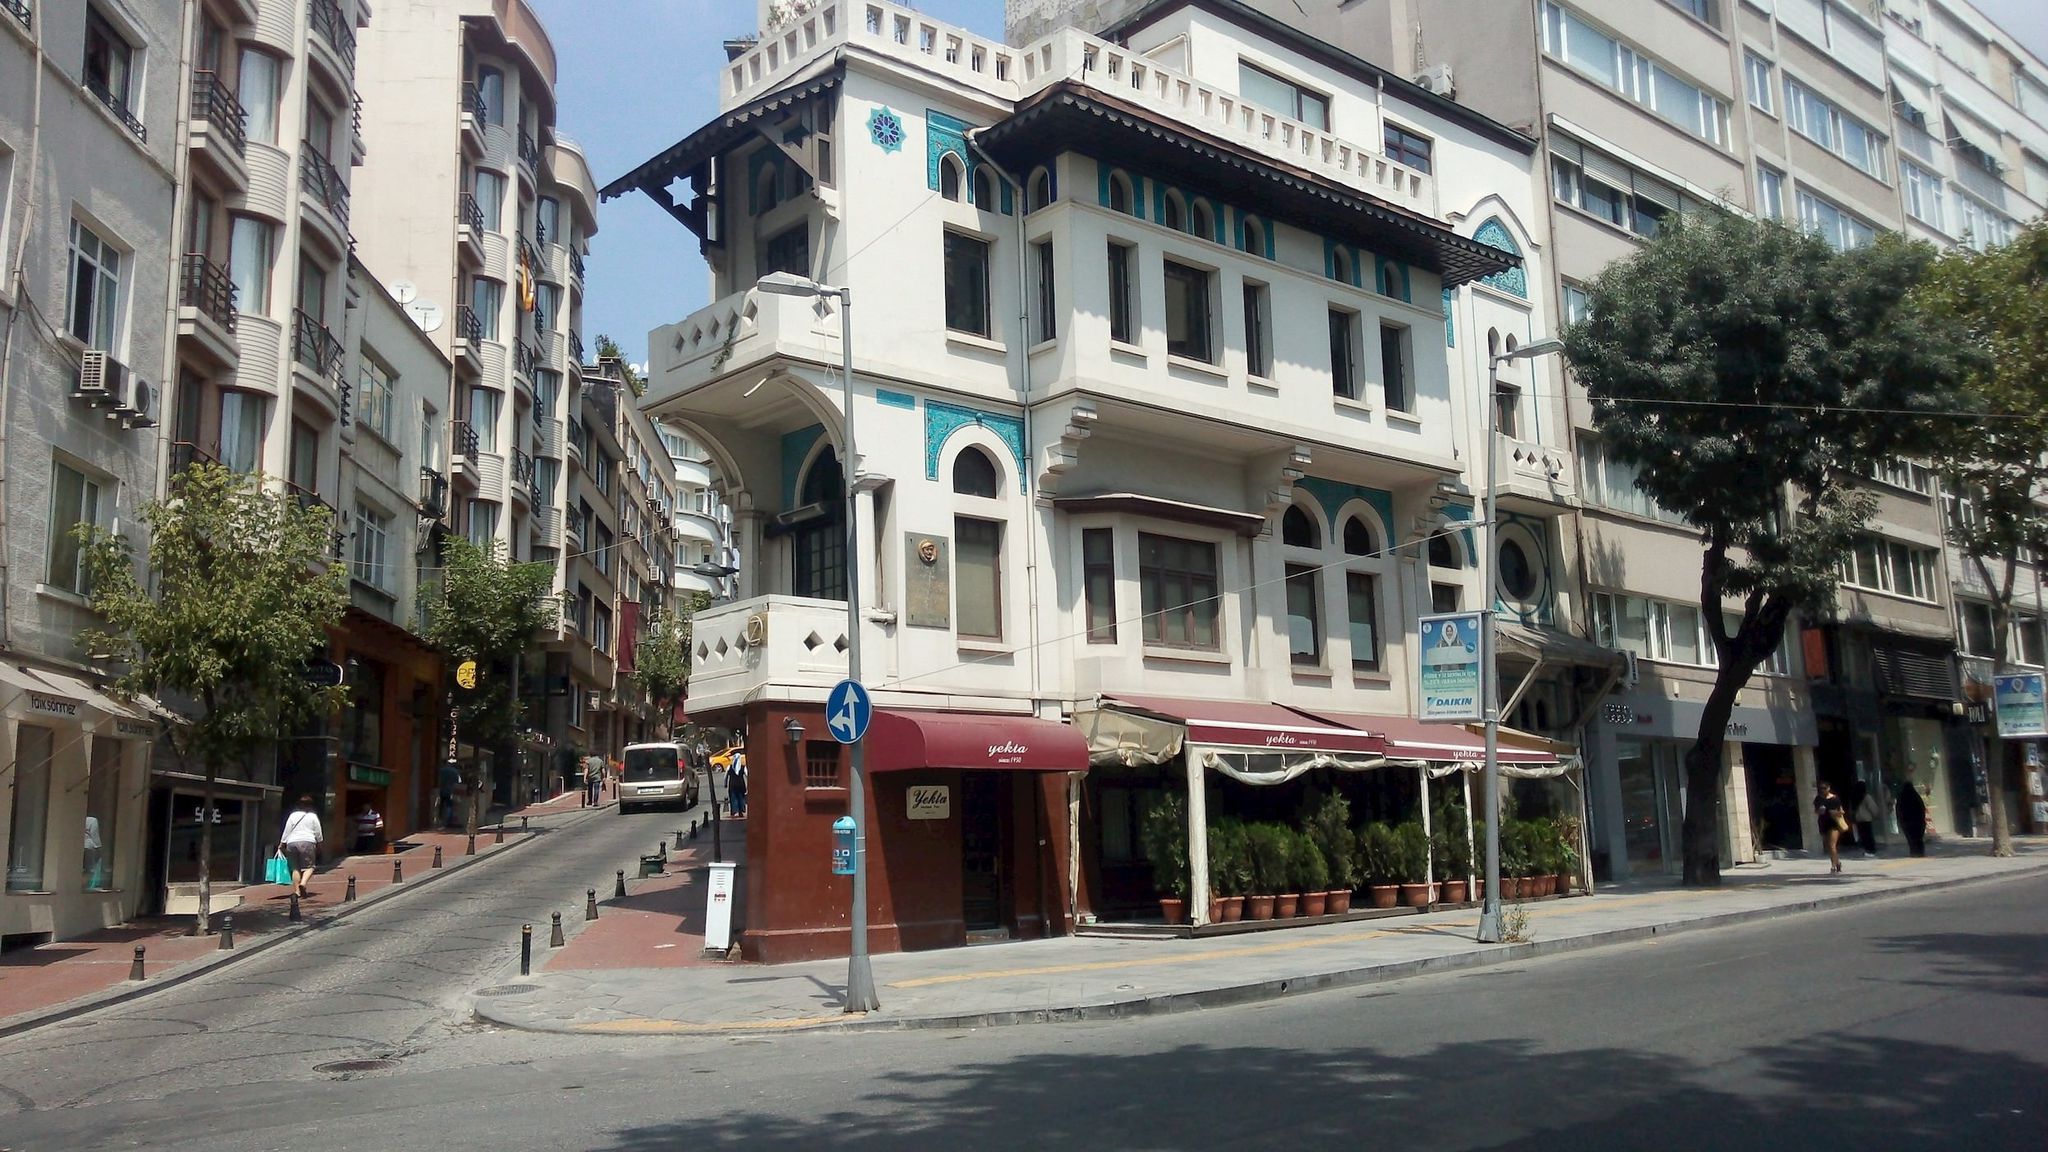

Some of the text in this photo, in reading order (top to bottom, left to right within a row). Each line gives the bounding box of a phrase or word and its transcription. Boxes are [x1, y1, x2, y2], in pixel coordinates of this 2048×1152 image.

[48, 698, 77, 716] sönmez
[1436, 697, 1473, 706] DAIKIN
[1266, 732, 1297, 746] yekta
[988, 741, 1028, 757] yekta
[1453, 751, 1478, 760] yekta
[912, 790, 948, 809] Yekta
